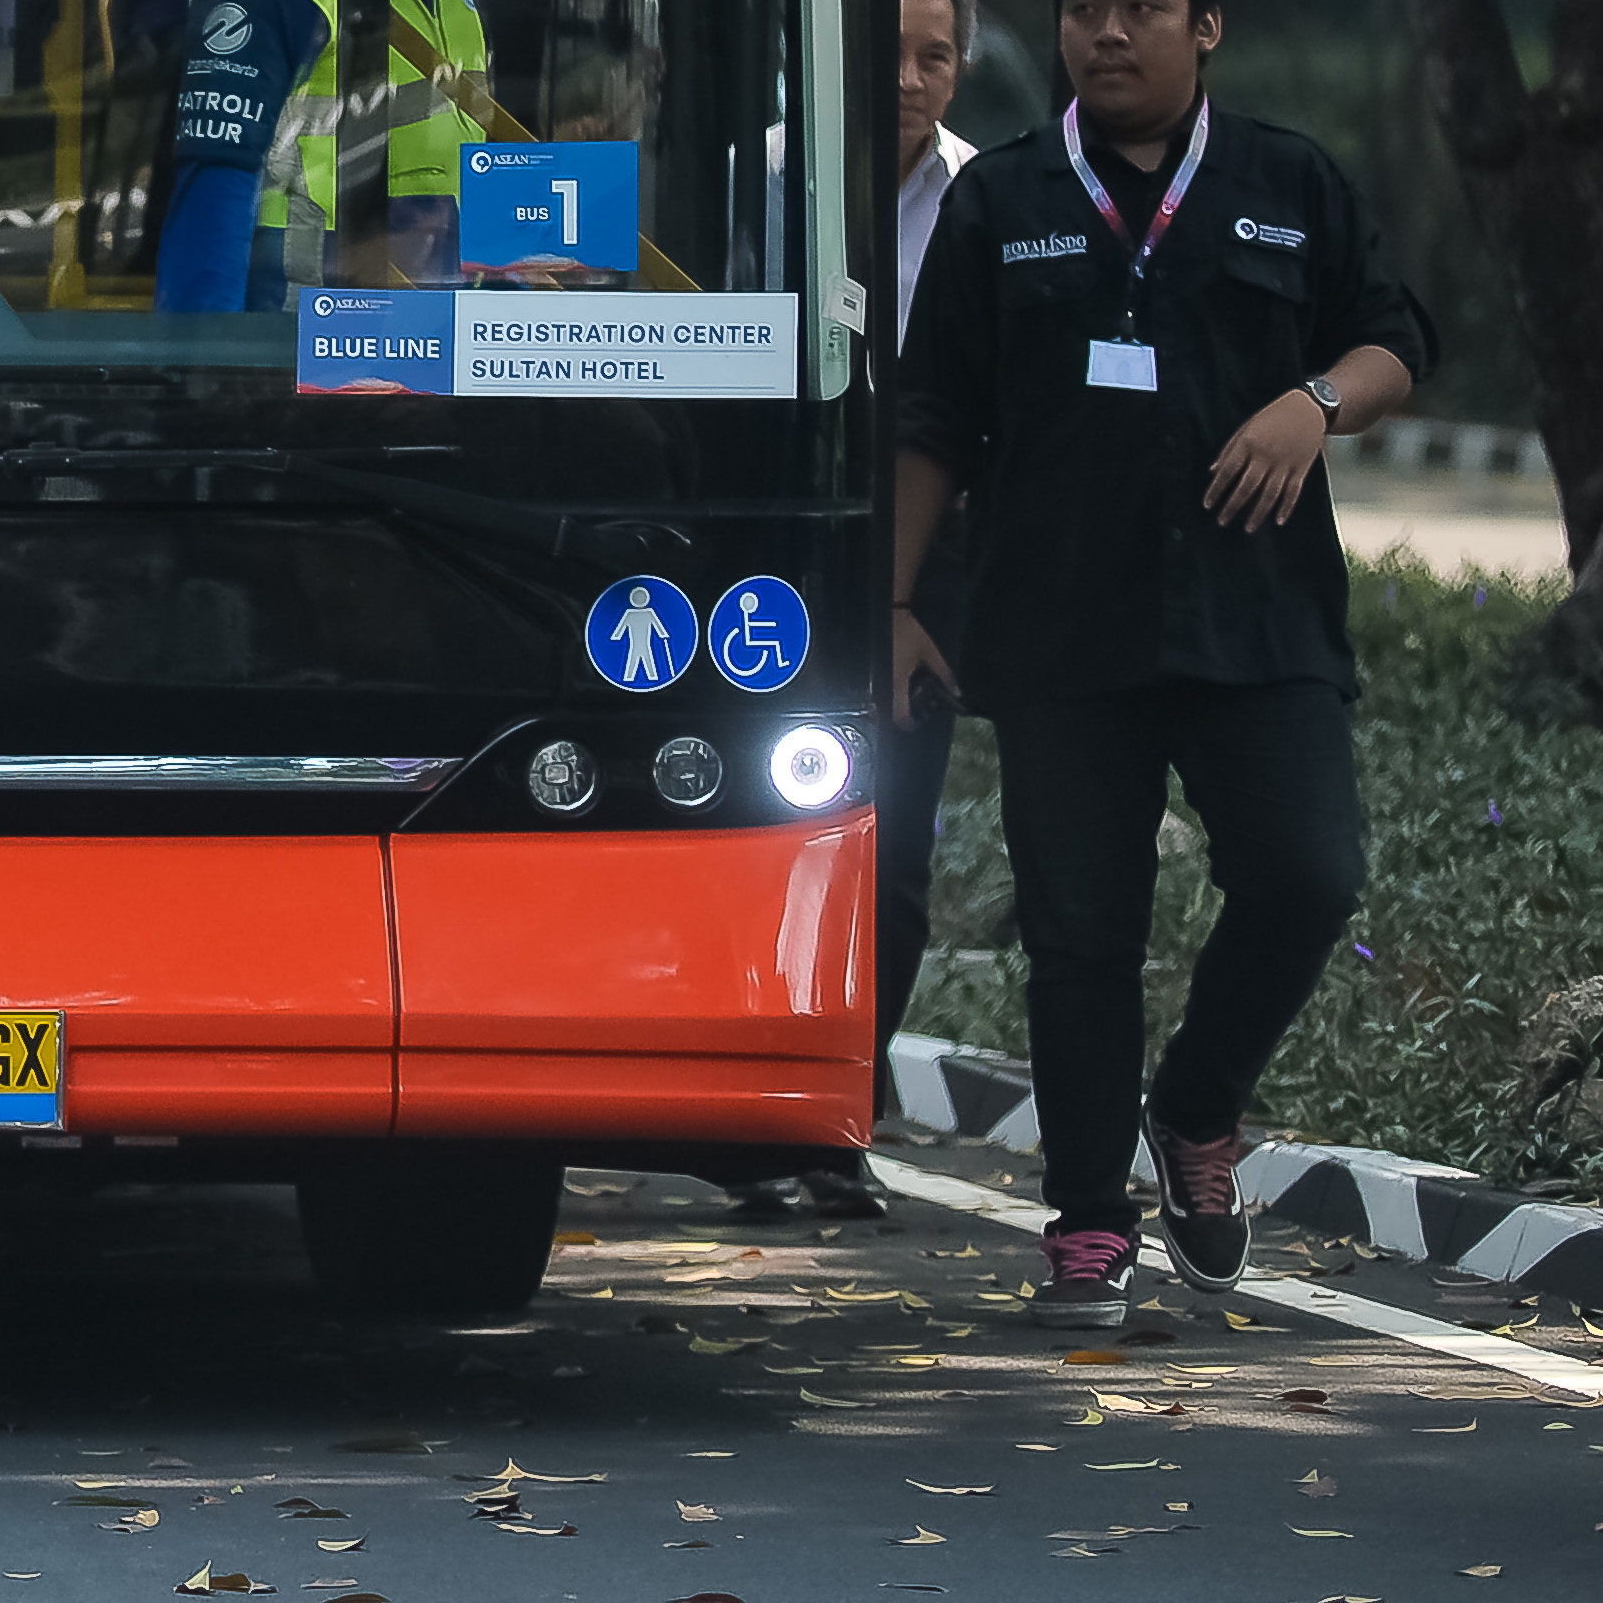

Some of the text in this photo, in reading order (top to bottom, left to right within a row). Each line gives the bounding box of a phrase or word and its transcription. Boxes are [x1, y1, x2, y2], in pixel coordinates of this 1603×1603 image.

[493, 154, 530, 165] ASEAN
[516, 179, 578, 245] BUS 1
[335, 298, 370, 309] ASEAN
[473, 323, 772, 345] REGISTRATION CENTER
[314, 336, 441, 359] BLUE LINE
[472, 359, 665, 380] SULTAN HOTEL
